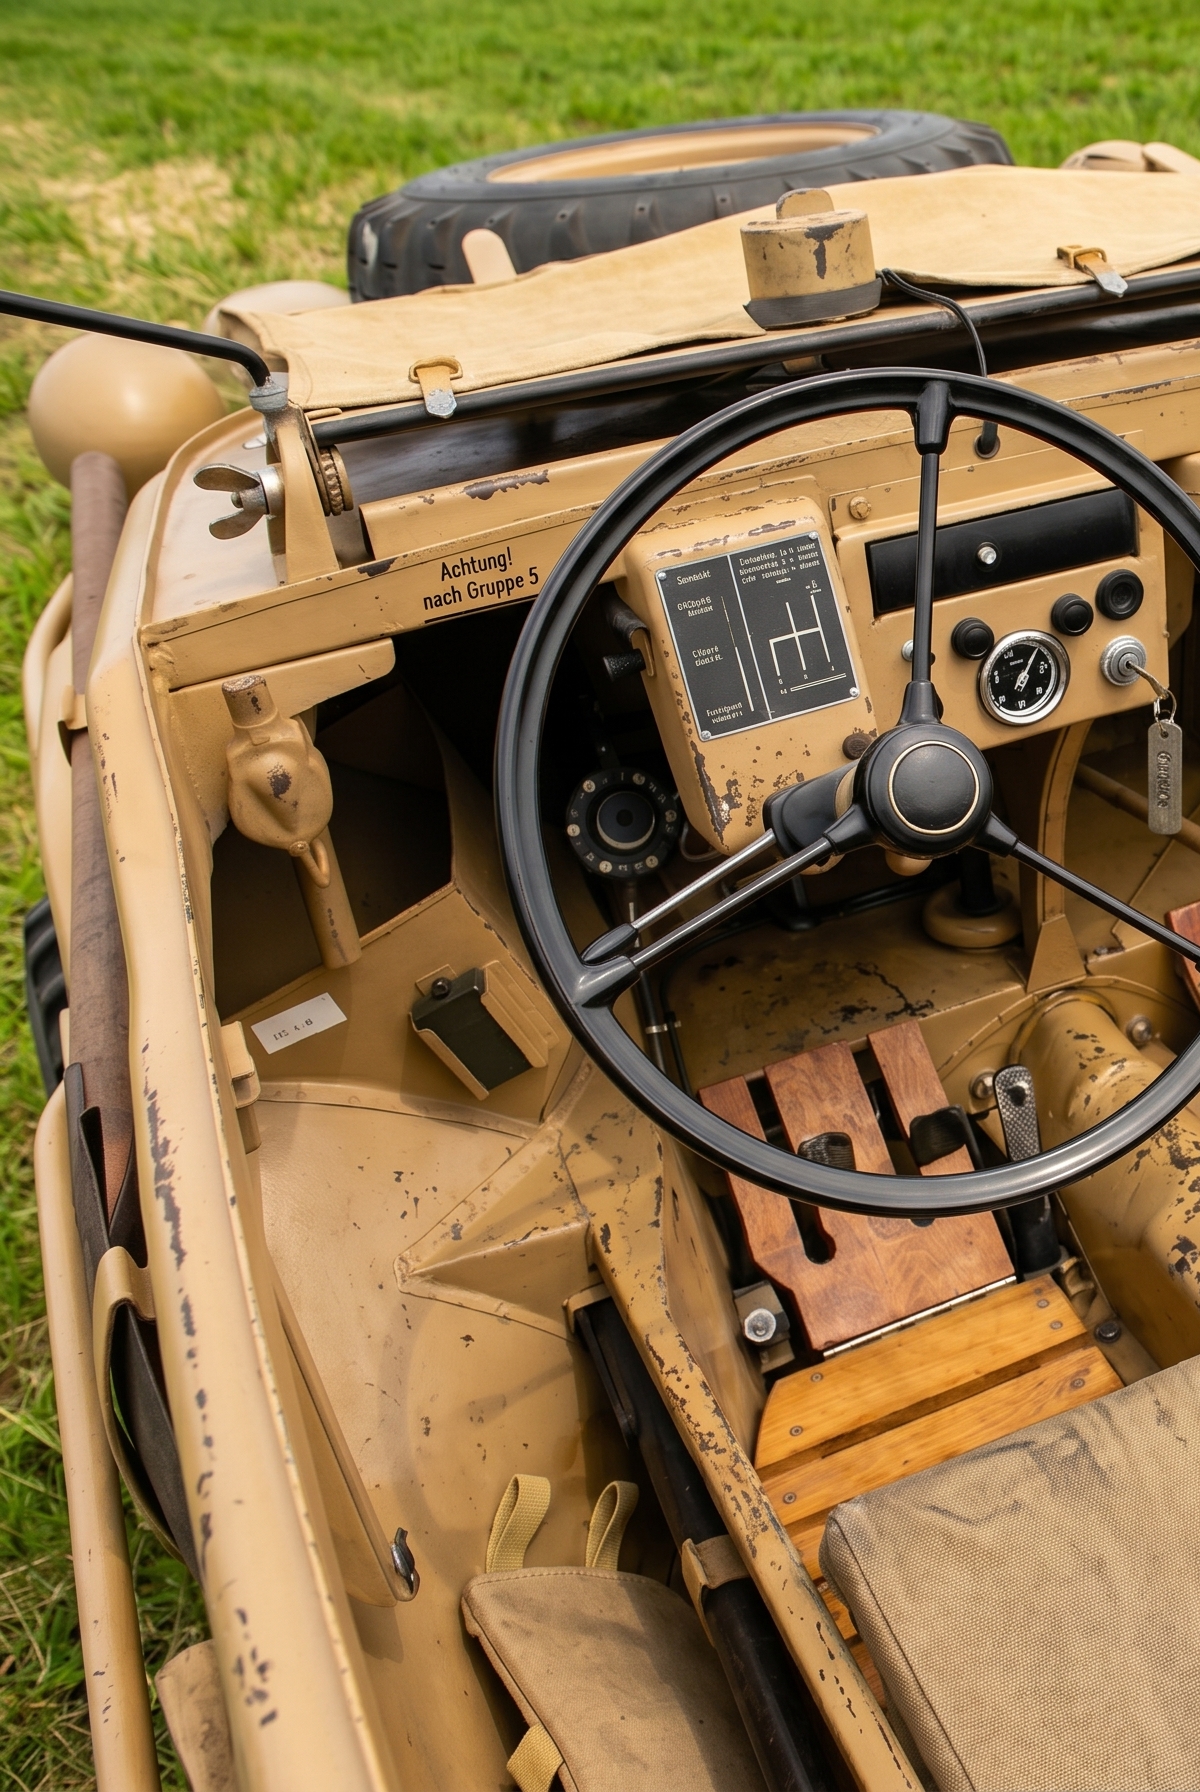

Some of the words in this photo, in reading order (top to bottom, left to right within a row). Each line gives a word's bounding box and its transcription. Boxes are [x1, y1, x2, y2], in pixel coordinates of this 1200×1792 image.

[441, 546, 512, 582] Achtung!
[423, 585, 462, 610] nach
[467, 574, 524, 599] Gruppe
[529, 566, 539, 585] 5
